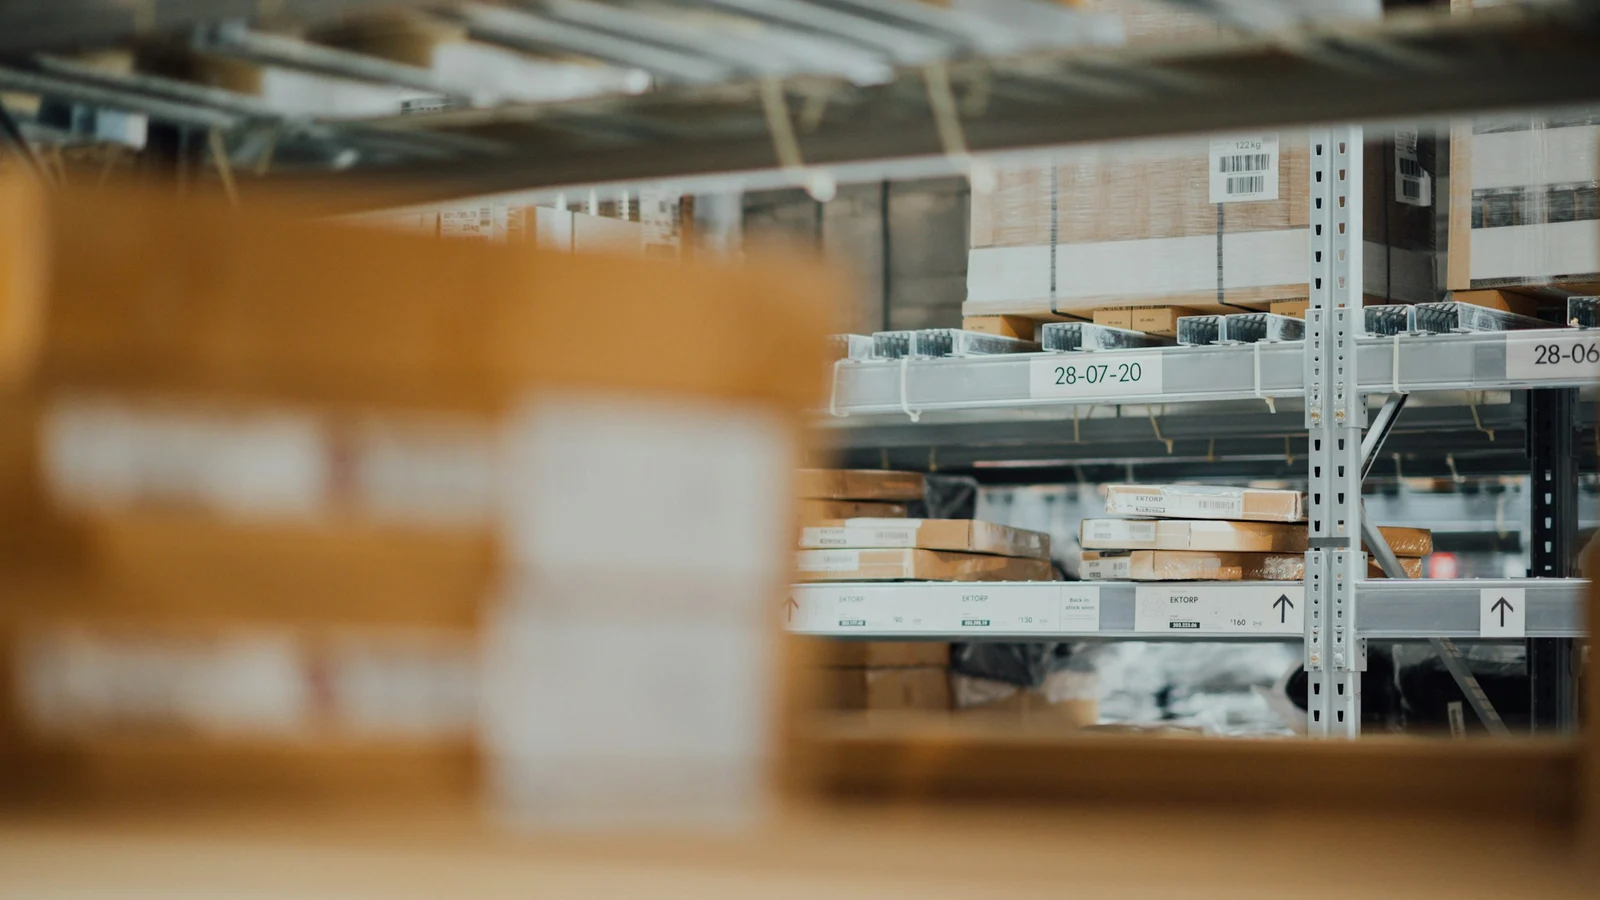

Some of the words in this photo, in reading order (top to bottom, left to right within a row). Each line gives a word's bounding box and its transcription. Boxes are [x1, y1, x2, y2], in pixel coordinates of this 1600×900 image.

[1534, 343, 1600, 365] 28-06
[1055, 362, 1142, 385] 28-07-20
[839, 595, 865, 603] EKTORP
[1169, 596, 1199, 604] EKTORP
[1018, 616, 1033, 624] 130
